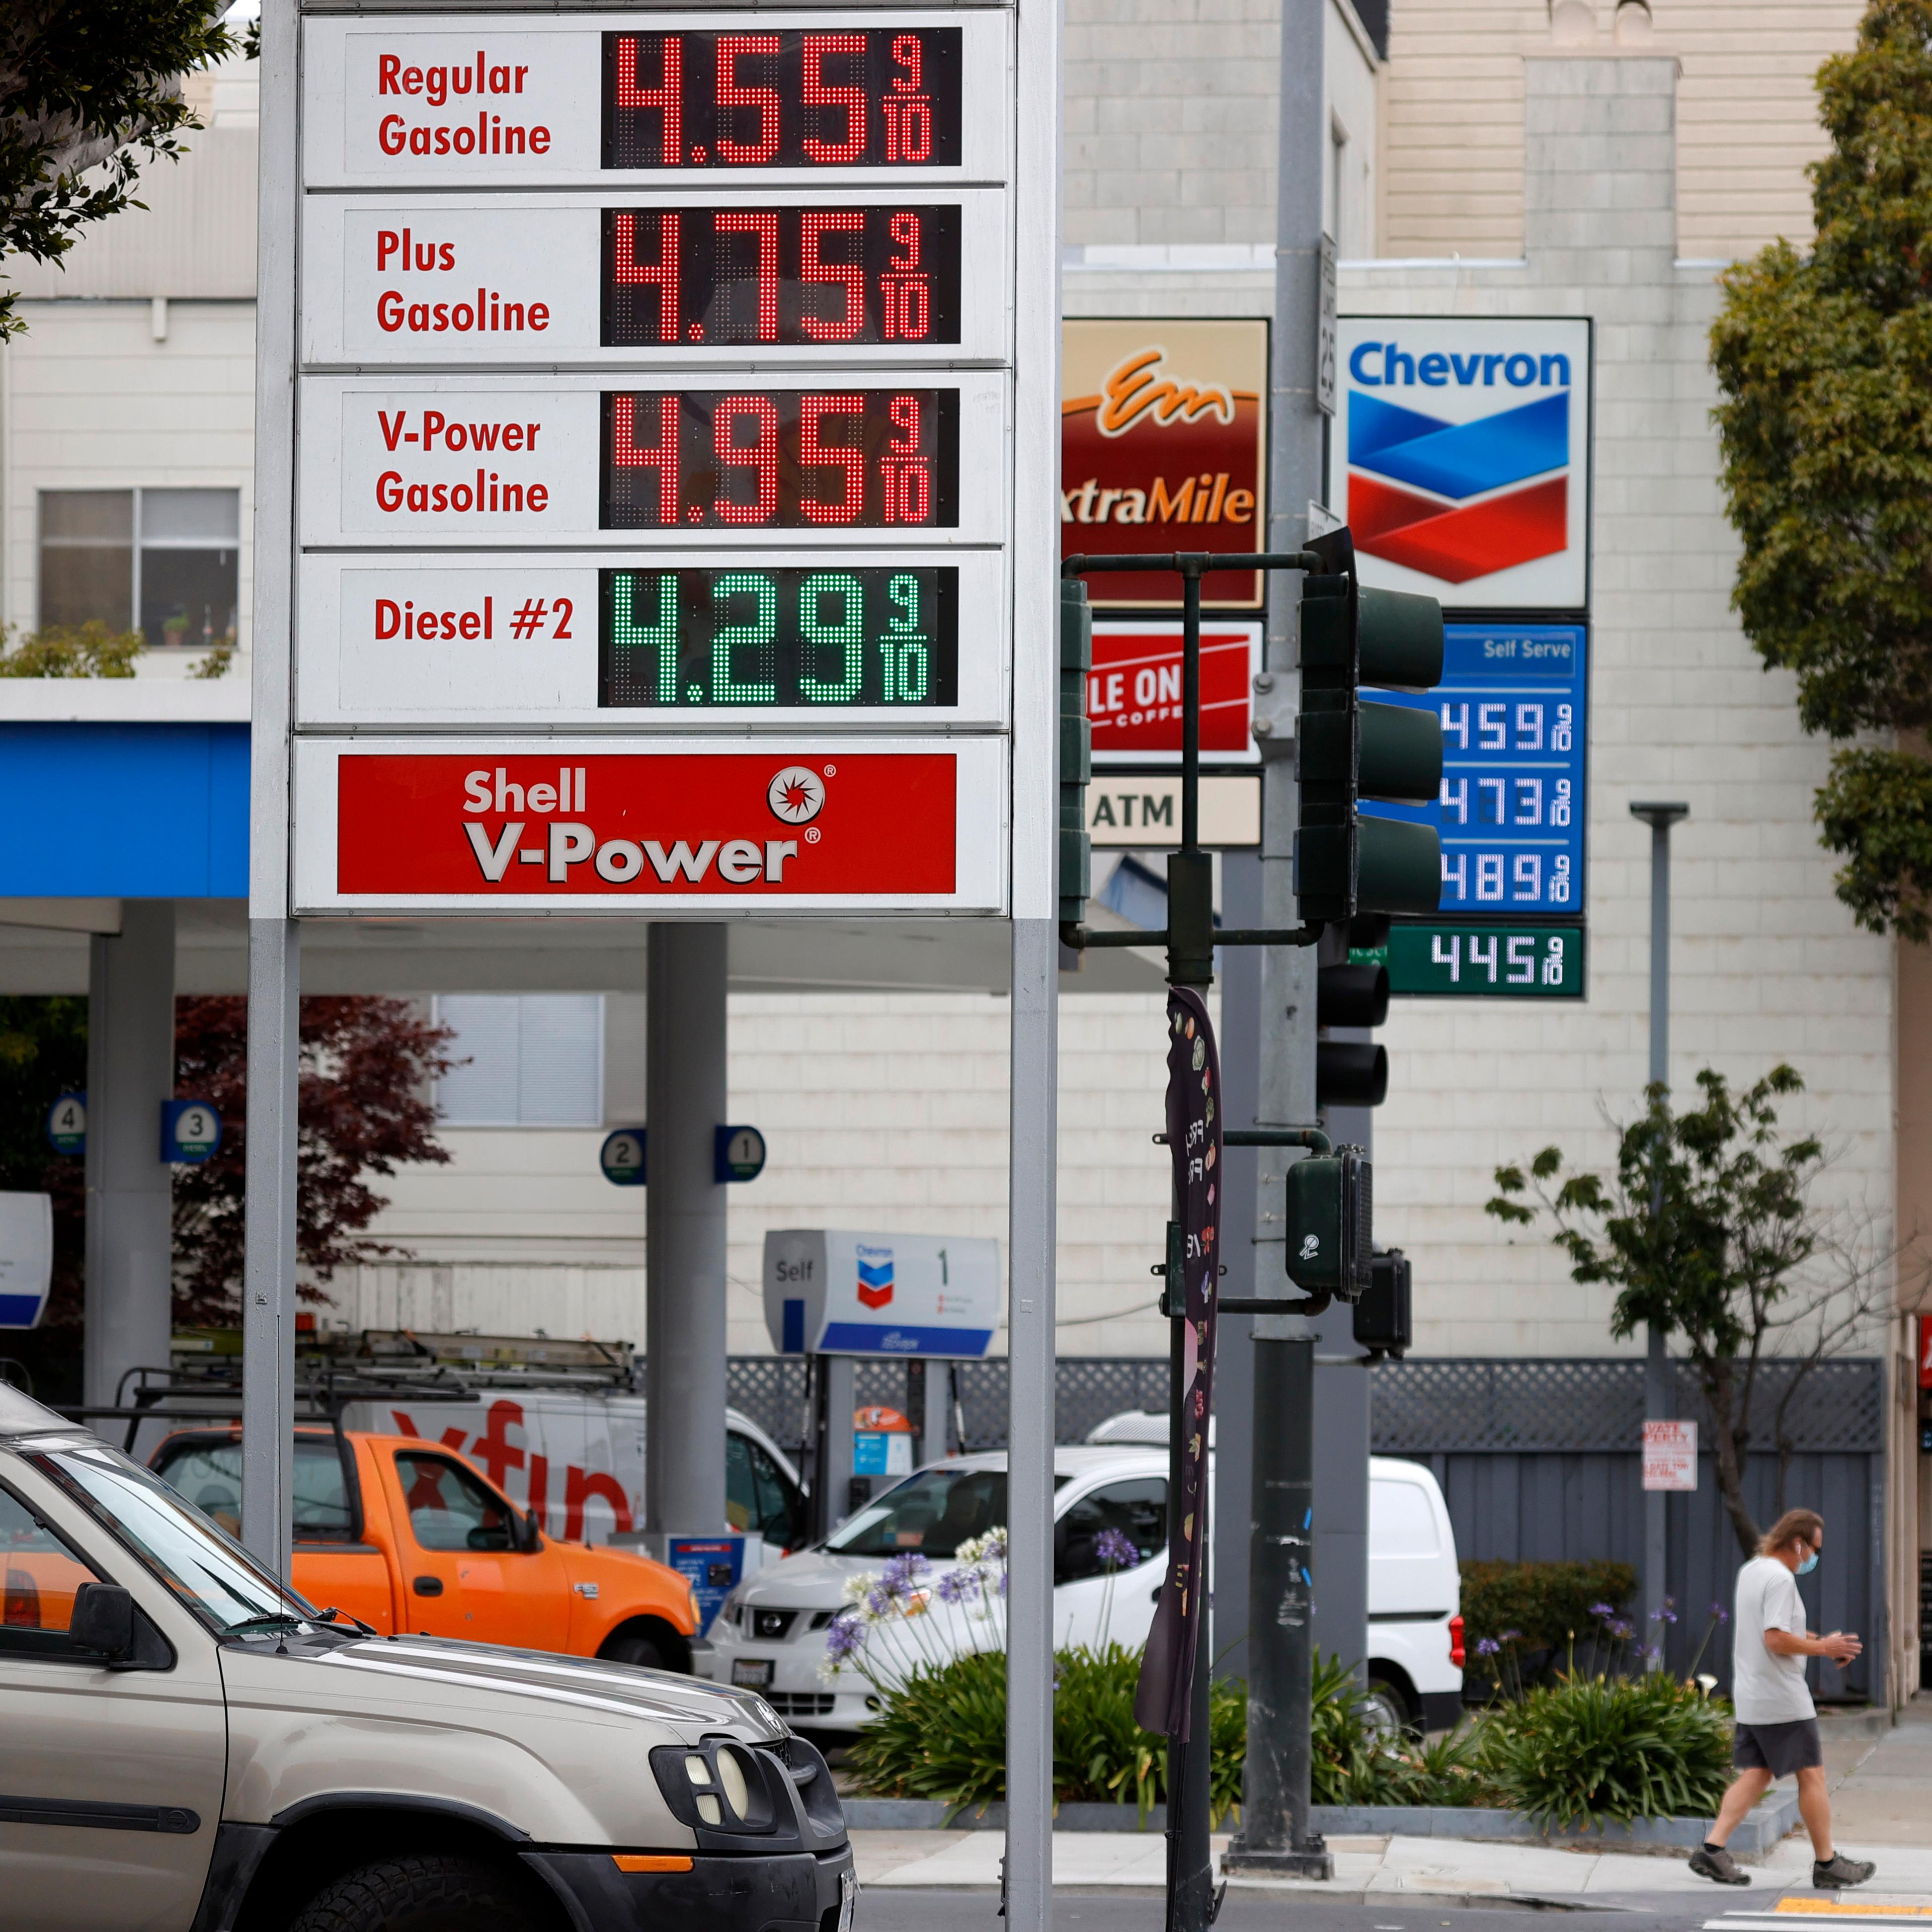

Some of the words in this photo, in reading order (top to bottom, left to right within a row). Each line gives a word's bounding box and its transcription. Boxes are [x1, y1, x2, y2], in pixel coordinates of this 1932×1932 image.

[381, 51, 528, 105] Regular
[380, 111, 550, 154] Gasoline
[378, 228, 455, 271] Plus
[378, 288, 549, 332] Gasoline
[1349, 341, 1571, 387] Chevron
[379, 411, 540, 451] V-Power
[377, 468, 548, 512] Gasoline
[1061, 472, 1256, 525] xtraMile
[376, 597, 492, 640] Diesel
[511, 598, 573, 639] #2
[1484, 639, 1516, 658] Self
[1522, 639, 1571, 658] Serve
[1086, 673, 1124, 714] LE
[1115, 705, 1183, 728] COFFE
[1440, 702, 1544, 750] 459
[463, 768, 586, 813] Shell
[1092, 794, 1174, 827] ATM
[1439, 778, 1543, 825] 473
[463, 822, 799, 884] V-Power
[1440, 853, 1542, 901] 489
[1431, 935, 1535, 983] 445
[61, 1106, 74, 1129] 4
[189, 1113, 203, 1137] 3
[616, 1143, 629, 1164] 2
[743, 1138, 749, 1160] 1
[776, 1259, 814, 1282] Self
[937, 1248, 948, 1286] 1
[392, 1400, 632, 1541] xfin
